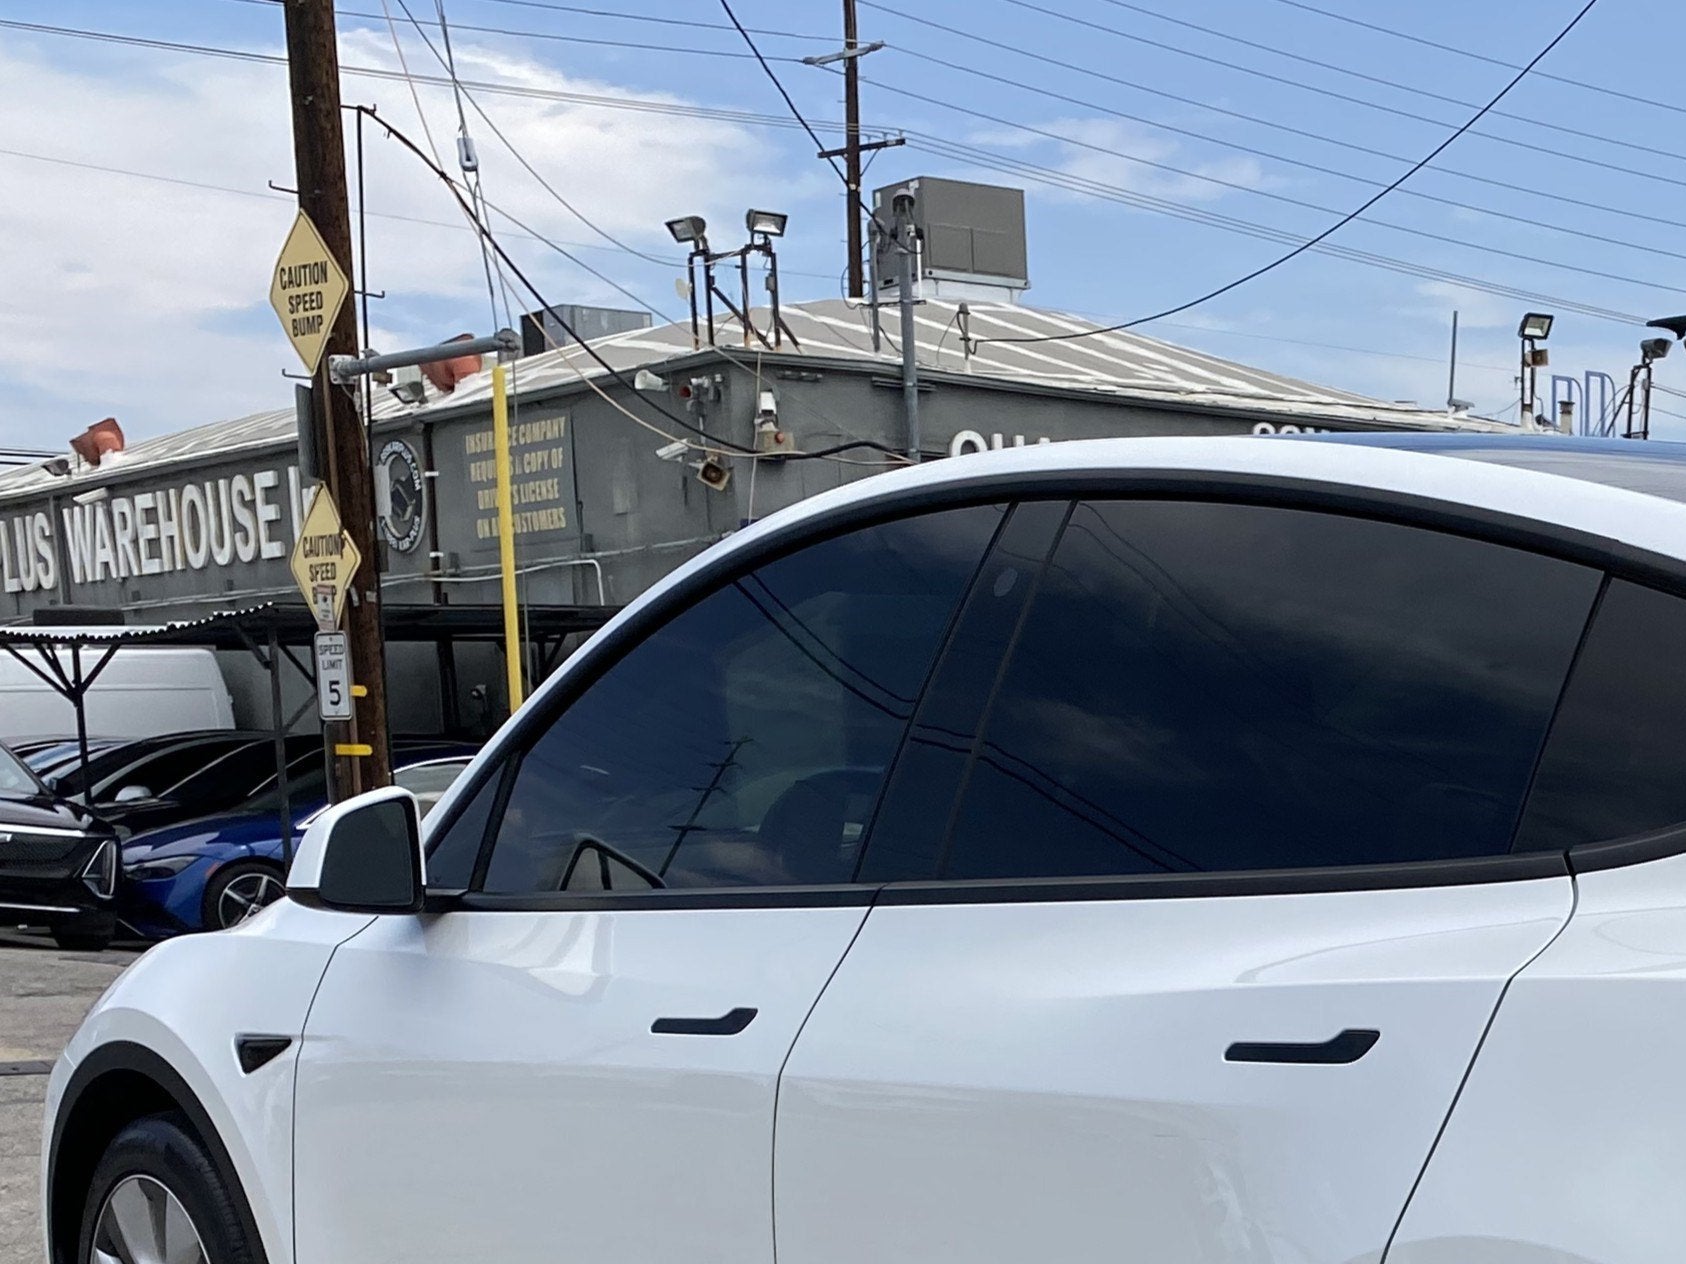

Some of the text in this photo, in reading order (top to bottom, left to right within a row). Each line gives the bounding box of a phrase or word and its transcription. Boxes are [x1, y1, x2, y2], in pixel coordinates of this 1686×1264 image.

[279, 260, 328, 290] CAUTION
[288, 291, 323, 315] SPEED
[291, 314, 323, 337] BUMP
[518, 416, 566, 445] COMPANY
[523, 449, 549, 473] COPY
[551, 447, 563, 469] OF
[520, 478, 559, 503] LICENSE
[0, 512, 57, 593] LUS
[62, 470, 285, 584] WAREHOUSE
[513, 506, 567, 533] USTOMERS
[302, 534, 342, 559] CAUTION
[309, 562, 336, 582] SPEED
[319, 644, 344, 656] SPEED
[321, 659, 343, 671] LIMIT
[329, 680, 341, 706] 5
